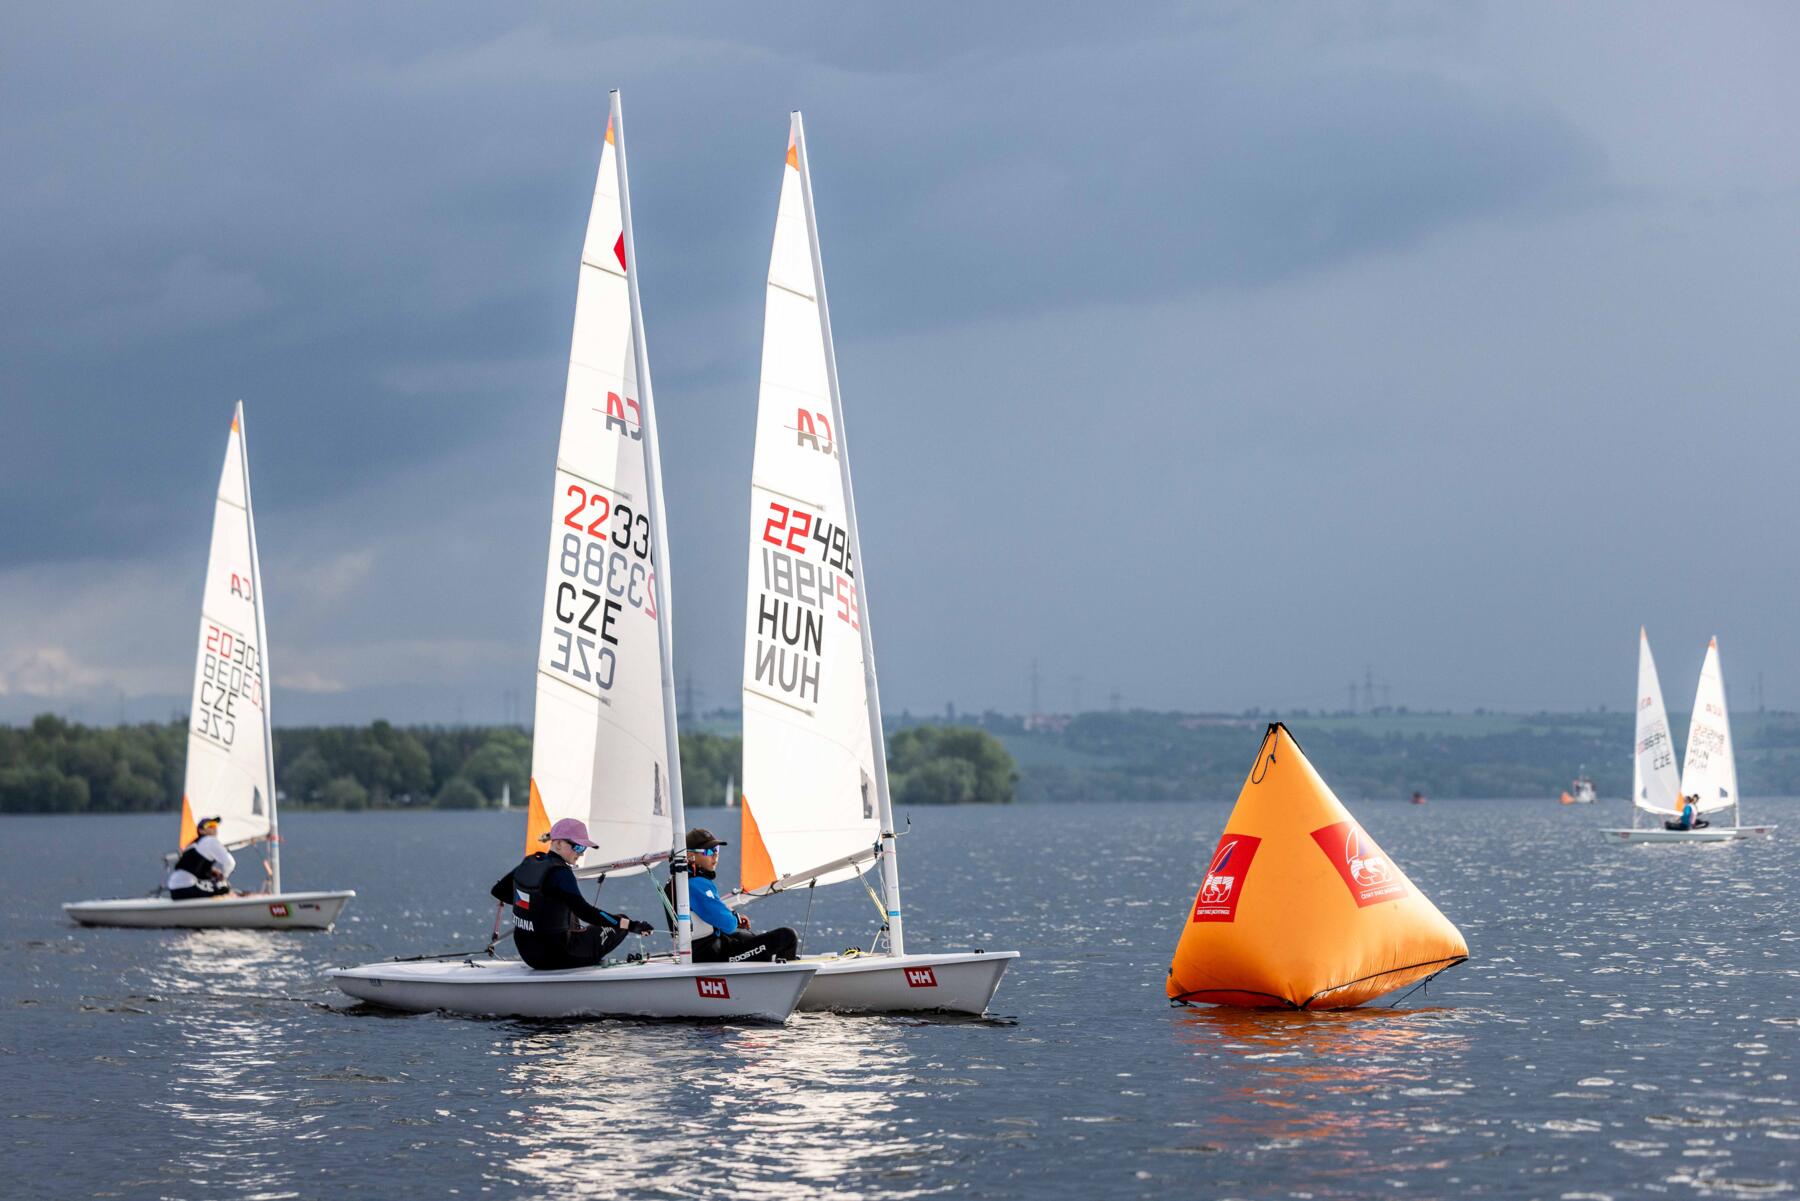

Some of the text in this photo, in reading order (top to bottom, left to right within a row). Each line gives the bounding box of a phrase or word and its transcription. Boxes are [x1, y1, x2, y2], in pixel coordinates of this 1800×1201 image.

[564, 485, 653, 566] 2233
[556, 582, 622, 645] CZE
[758, 594, 823, 656] HUN
[200, 681, 239, 718] CZE
[1653, 753, 1671, 770] CZE
[701, 981, 725, 995] HH
[909, 970, 932, 984] HH
